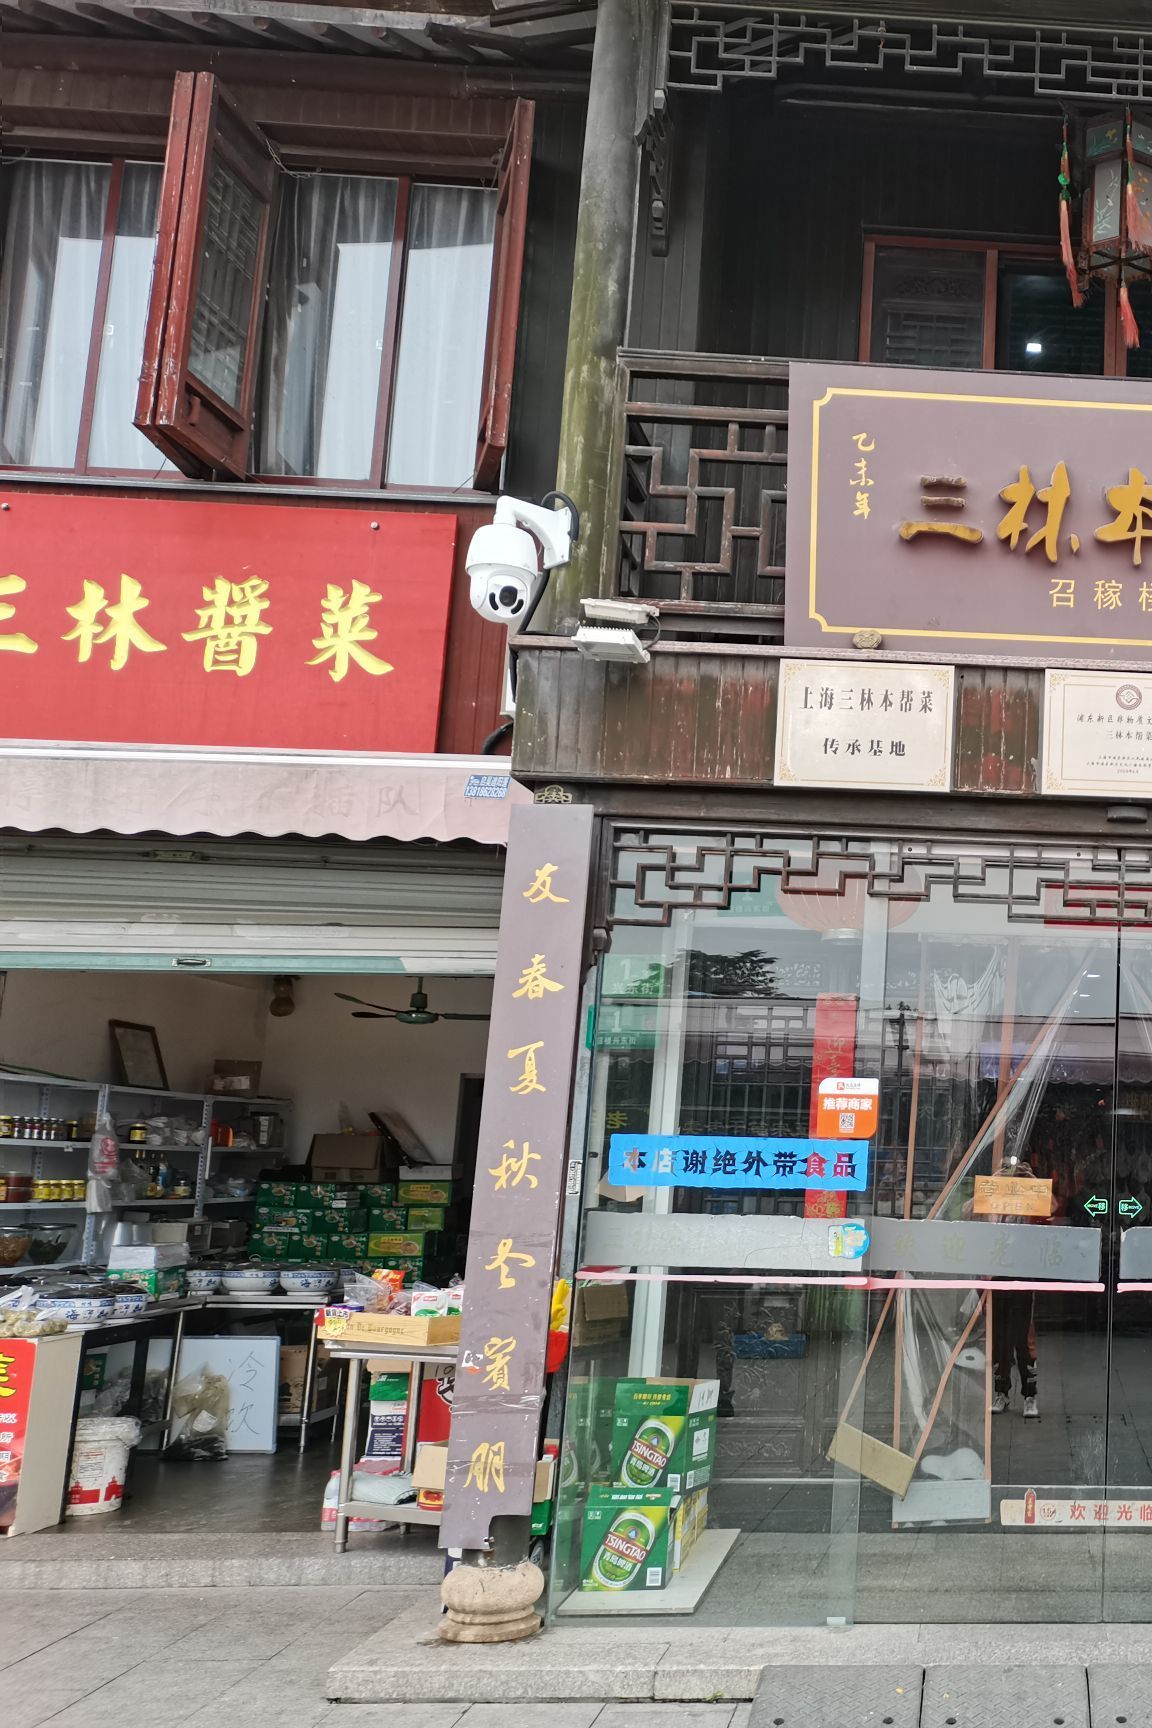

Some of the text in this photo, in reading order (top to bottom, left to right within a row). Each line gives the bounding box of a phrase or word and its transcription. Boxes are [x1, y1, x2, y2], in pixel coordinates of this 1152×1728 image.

[800, 686, 933, 714] 上海三林本帮菜
[823, 737, 906, 757] 传承基地
[823, 1097, 873, 1111] 推荐商家
[622, 1145, 859, 1179] 本店谢绝外带食品
[979, 1180, 1049, 1197] 营业中
[631, 1439, 668, 1468] TSINGTAO
[605, 1533, 647, 1562] TSINGTAO
